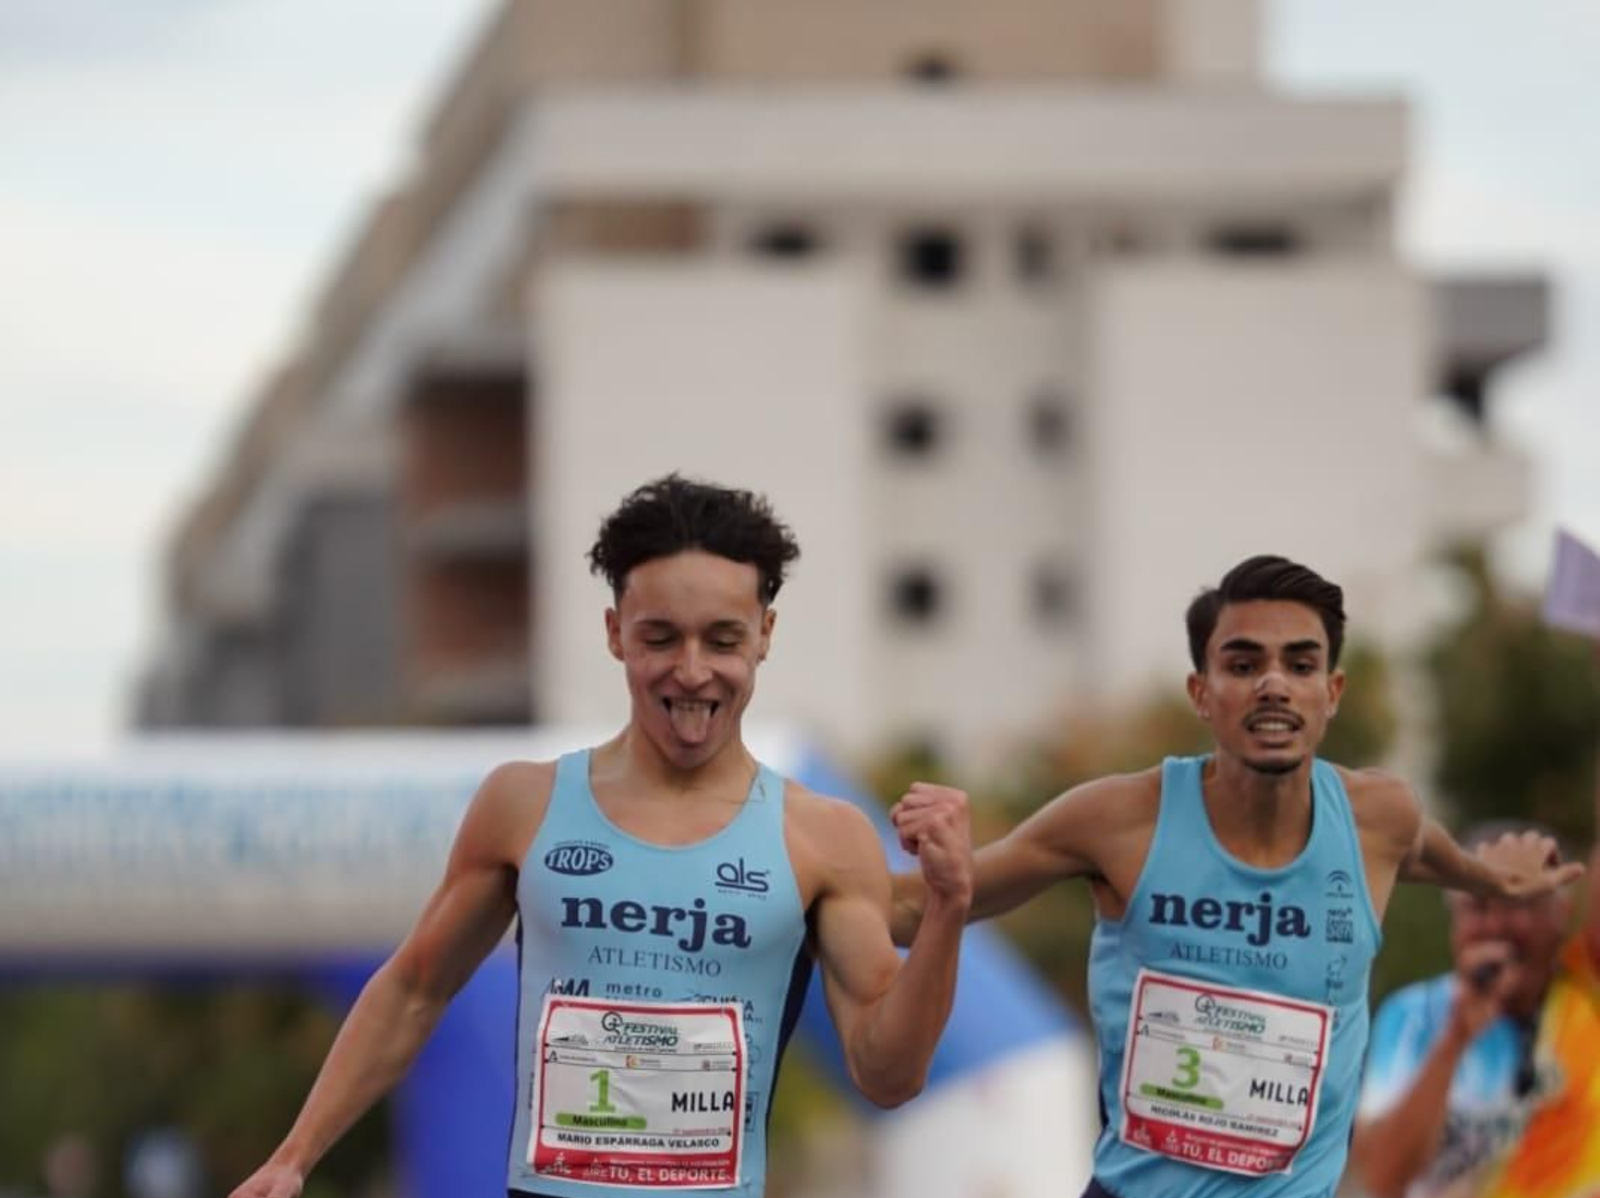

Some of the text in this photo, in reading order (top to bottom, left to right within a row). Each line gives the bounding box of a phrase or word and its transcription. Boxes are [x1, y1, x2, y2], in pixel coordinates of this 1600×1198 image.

[546, 847, 612, 872] TROPS
[561, 896, 752, 953] nerja
[1148, 892, 1311, 946] nerja
[587, 945, 722, 977] ATLETISMO
[1169, 942, 1288, 971] ATLETISMO
[605, 982, 663, 998] metro
[623, 1022, 678, 1035] FESTIVAL
[602, 1034, 679, 1048] ATLETISMO
[1171, 1044, 1201, 1090] 3
[589, 1069, 616, 1113] 1
[671, 1090, 735, 1113] MILLA
[1249, 1078, 1310, 1106] MILLA
[572, 1115, 628, 1128] Masculino
[557, 1133, 592, 1146] MARIO
[668, 1138, 720, 1149] VELASCO
[1207, 1149, 1224, 1163] EL
[638, 1169, 655, 1182] EL
